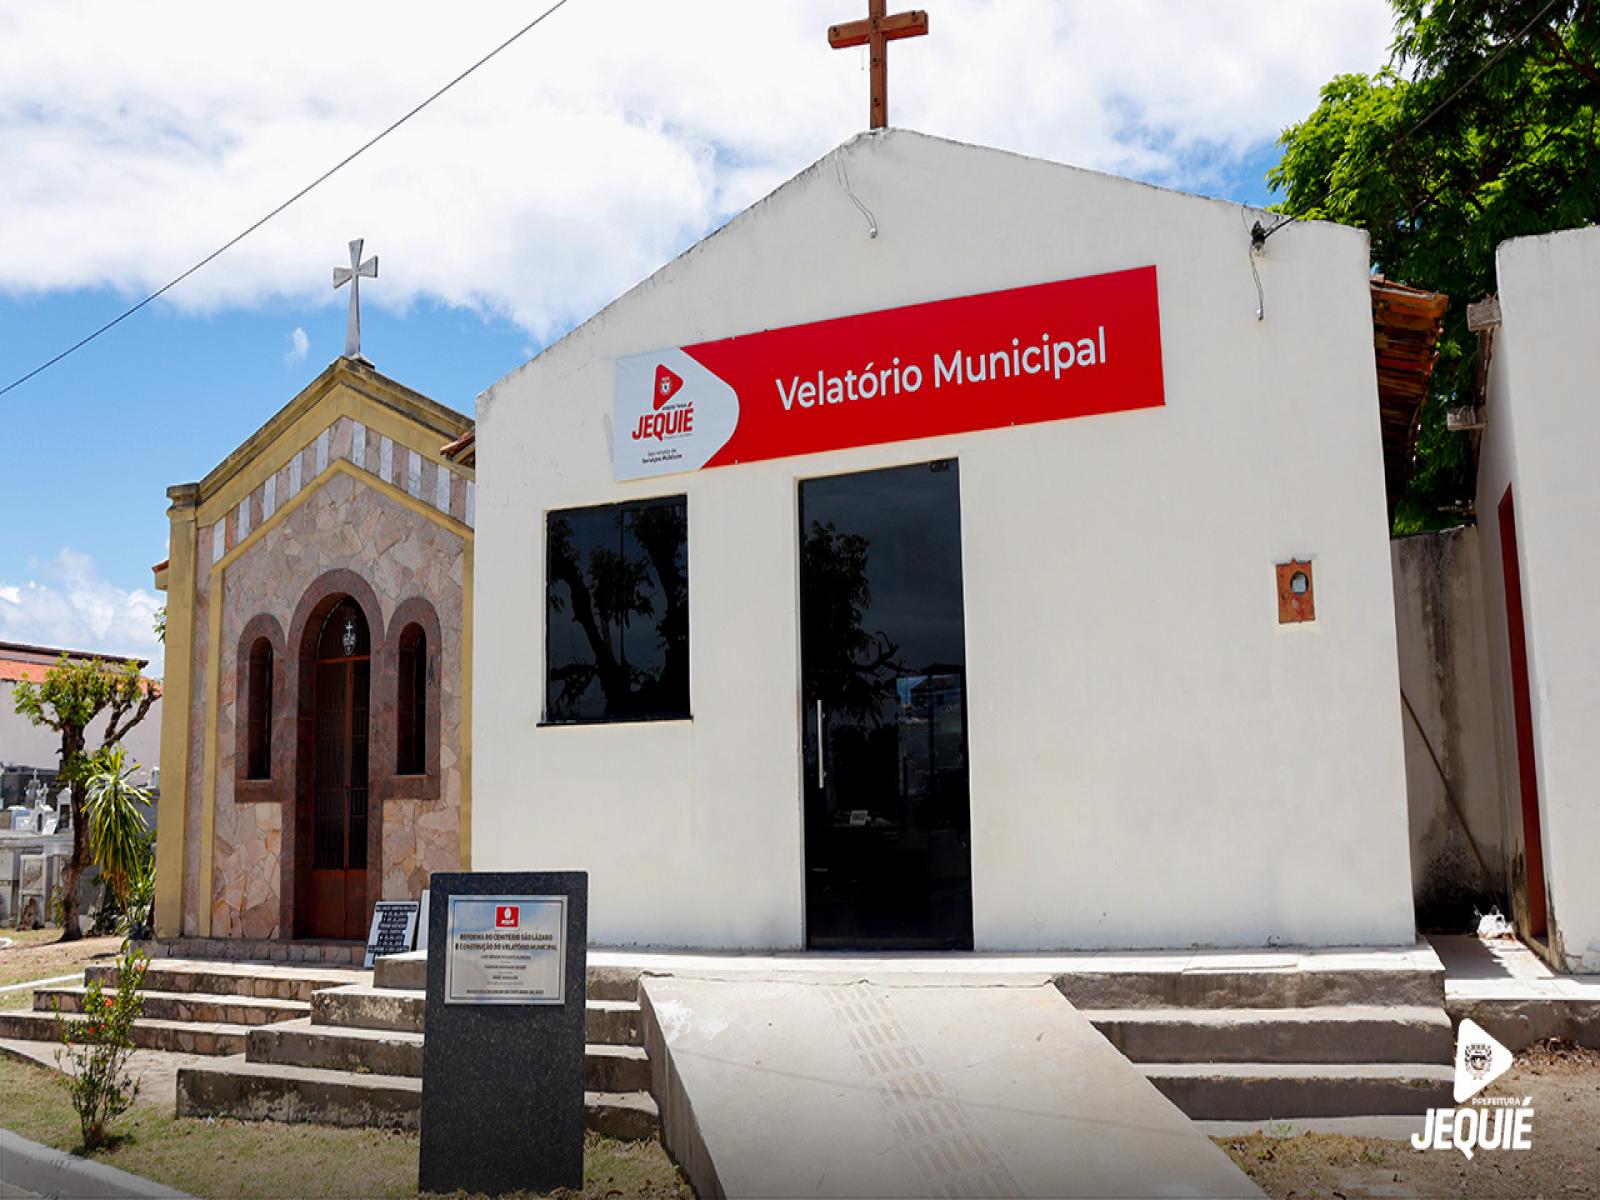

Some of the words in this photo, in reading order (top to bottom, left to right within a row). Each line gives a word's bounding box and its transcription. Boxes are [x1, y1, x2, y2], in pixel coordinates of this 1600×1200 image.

[775, 357, 923, 411] Velatório
[933, 326, 1107, 388] Municipal
[631, 401, 694, 442] JEQUIÉ
